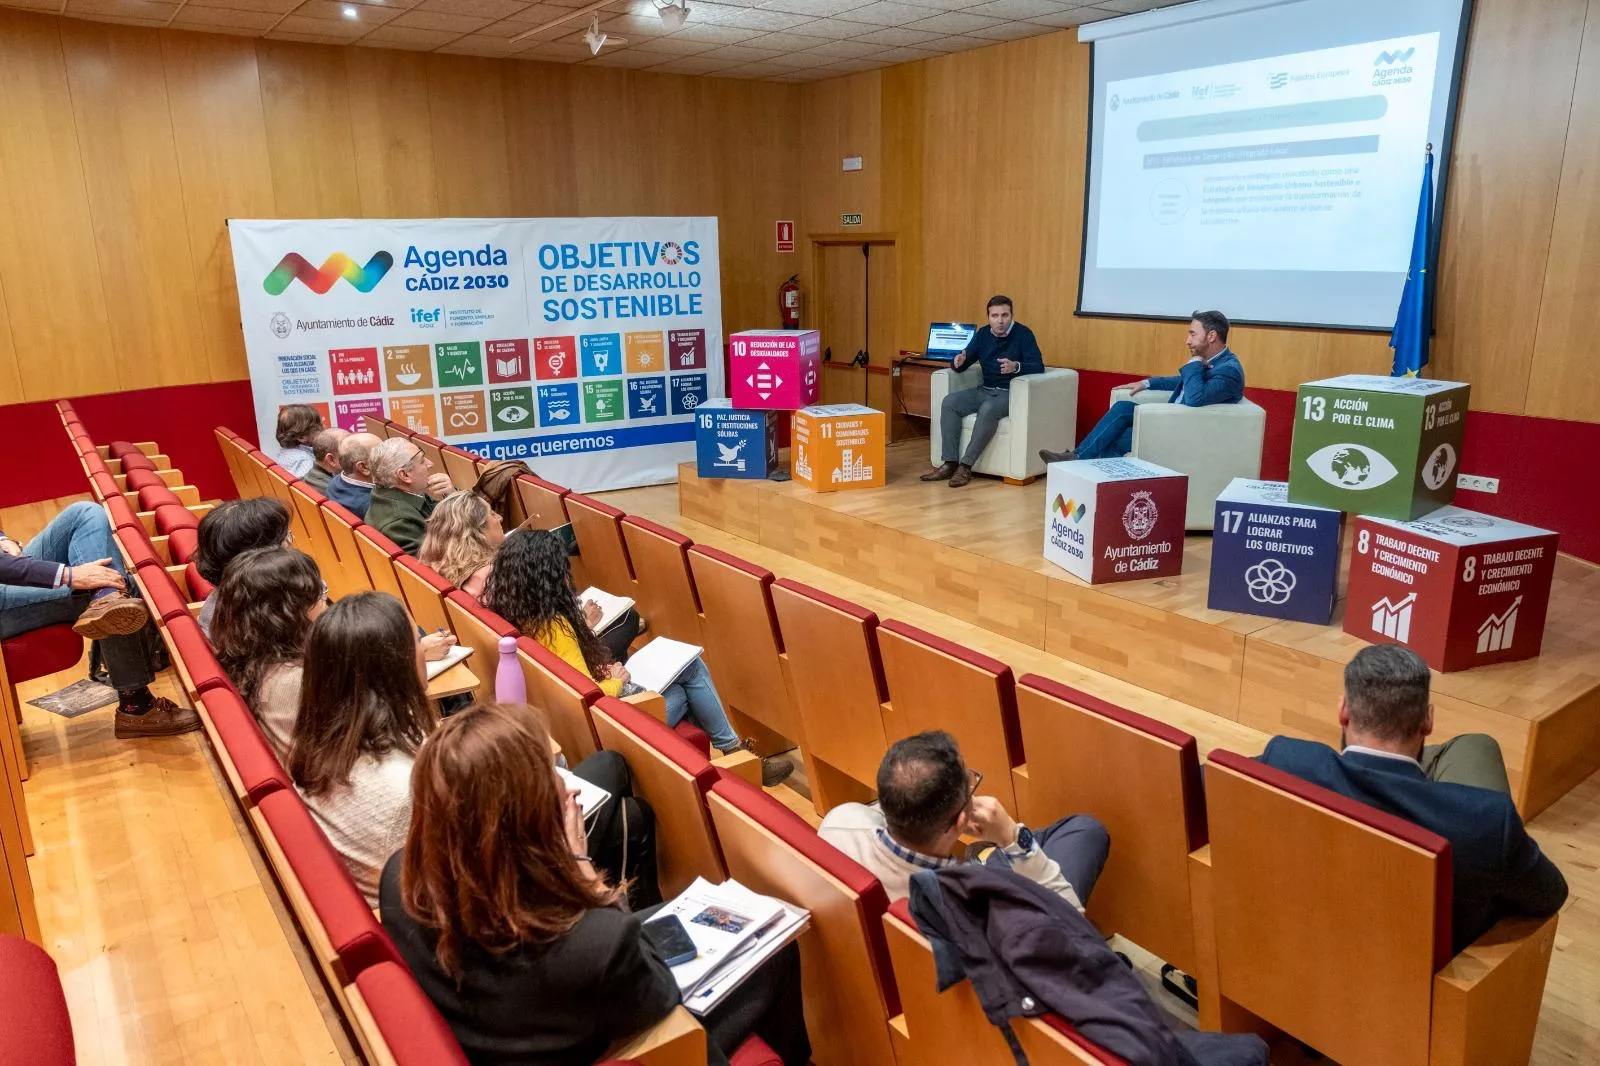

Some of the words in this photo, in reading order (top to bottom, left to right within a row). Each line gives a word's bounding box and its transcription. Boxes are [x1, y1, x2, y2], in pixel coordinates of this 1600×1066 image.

[1372, 64, 1414, 79] Agenda
[843, 215, 861, 224] SALIDA
[404, 244, 508, 274] Agenda
[539, 240, 701, 271] OBJETIVOS
[405, 274, 460, 291] CÁDIZ
[463, 275, 509, 290] 2030
[541, 275, 569, 293] DE
[573, 271, 702, 292] DESARROLLO
[410, 308, 440, 322] ifef
[543, 293, 703, 322] SOSTENIBLE
[296, 317, 356, 332] Ayuntamiento
[357, 316, 368, 328] de
[369, 316, 395, 327] Cádiz
[536, 340, 542, 350] 5
[583, 337, 588, 348] 6
[627, 335, 632, 345] 7
[670, 333, 676, 342] 8
[750, 340, 778, 349] REDUCCIÓN
[786, 341, 796, 349] LAS
[387, 350, 393, 360] 2
[439, 347, 445, 357] 3
[489, 344, 495, 353] 4
[732, 341, 747, 357] 10
[750, 350, 789, 358] DESIGUALDADES
[331, 353, 337, 363] 1
[281, 377, 319, 386] OBJETIVOS
[629, 381, 638, 391] 16
[672, 378, 680, 387] 17
[492, 392, 501, 402] 13
[539, 388, 548, 398] 14
[585, 384, 594, 395] 15
[392, 400, 400, 410] 11
[442, 396, 452, 406] 12
[1302, 395, 1326, 422] 13
[1333, 397, 1368, 412] ACCIÓN
[337, 404, 348, 415] 10
[699, 414, 713, 429] 16
[1332, 413, 1350, 425] POR
[1353, 415, 1363, 426] EL
[1365, 417, 1394, 430] CLIMA
[1425, 404, 1436, 431] 13
[721, 422, 758, 430] INSTITUCIONES
[820, 422, 832, 439] 11
[717, 430, 739, 438] SÓLIDAS
[495, 444, 527, 460] que
[531, 435, 615, 457] queremos
[1220, 510, 1243, 534] 17
[1248, 512, 1290, 526] ALIANZAS
[1292, 516, 1317, 529] PARA
[1051, 517, 1084, 546] Agenda
[1247, 525, 1283, 539] LOGRAR
[1050, 534, 1067, 552] CÁDIZ
[1067, 546, 1084, 560] 2030
[1245, 539, 1263, 550] LOS
[1265, 541, 1314, 556] OBJETIVOS
[1357, 528, 1371, 554] 8
[1375, 533, 1407, 553] TRABAJO
[1407, 542, 1441, 563] DECENTE
[1104, 540, 1171, 560] Ayuntamiento
[1483, 551, 1514, 566] TRABAJO
[1514, 546, 1544, 561] DECENTE
[1114, 560, 1127, 573] de
[1129, 557, 1159, 571] Cádiz
[1373, 547, 1379, 559] Y
[1379, 549, 1428, 574] CRECIMIENTO
[1371, 562, 1414, 585] ECONÓMICO
[1462, 555, 1476, 583] 8
[1480, 569, 1486, 581] Y
[1486, 562, 1533, 579] CRECIMIENTO
[1478, 579, 1520, 596] ECONÓMICO
